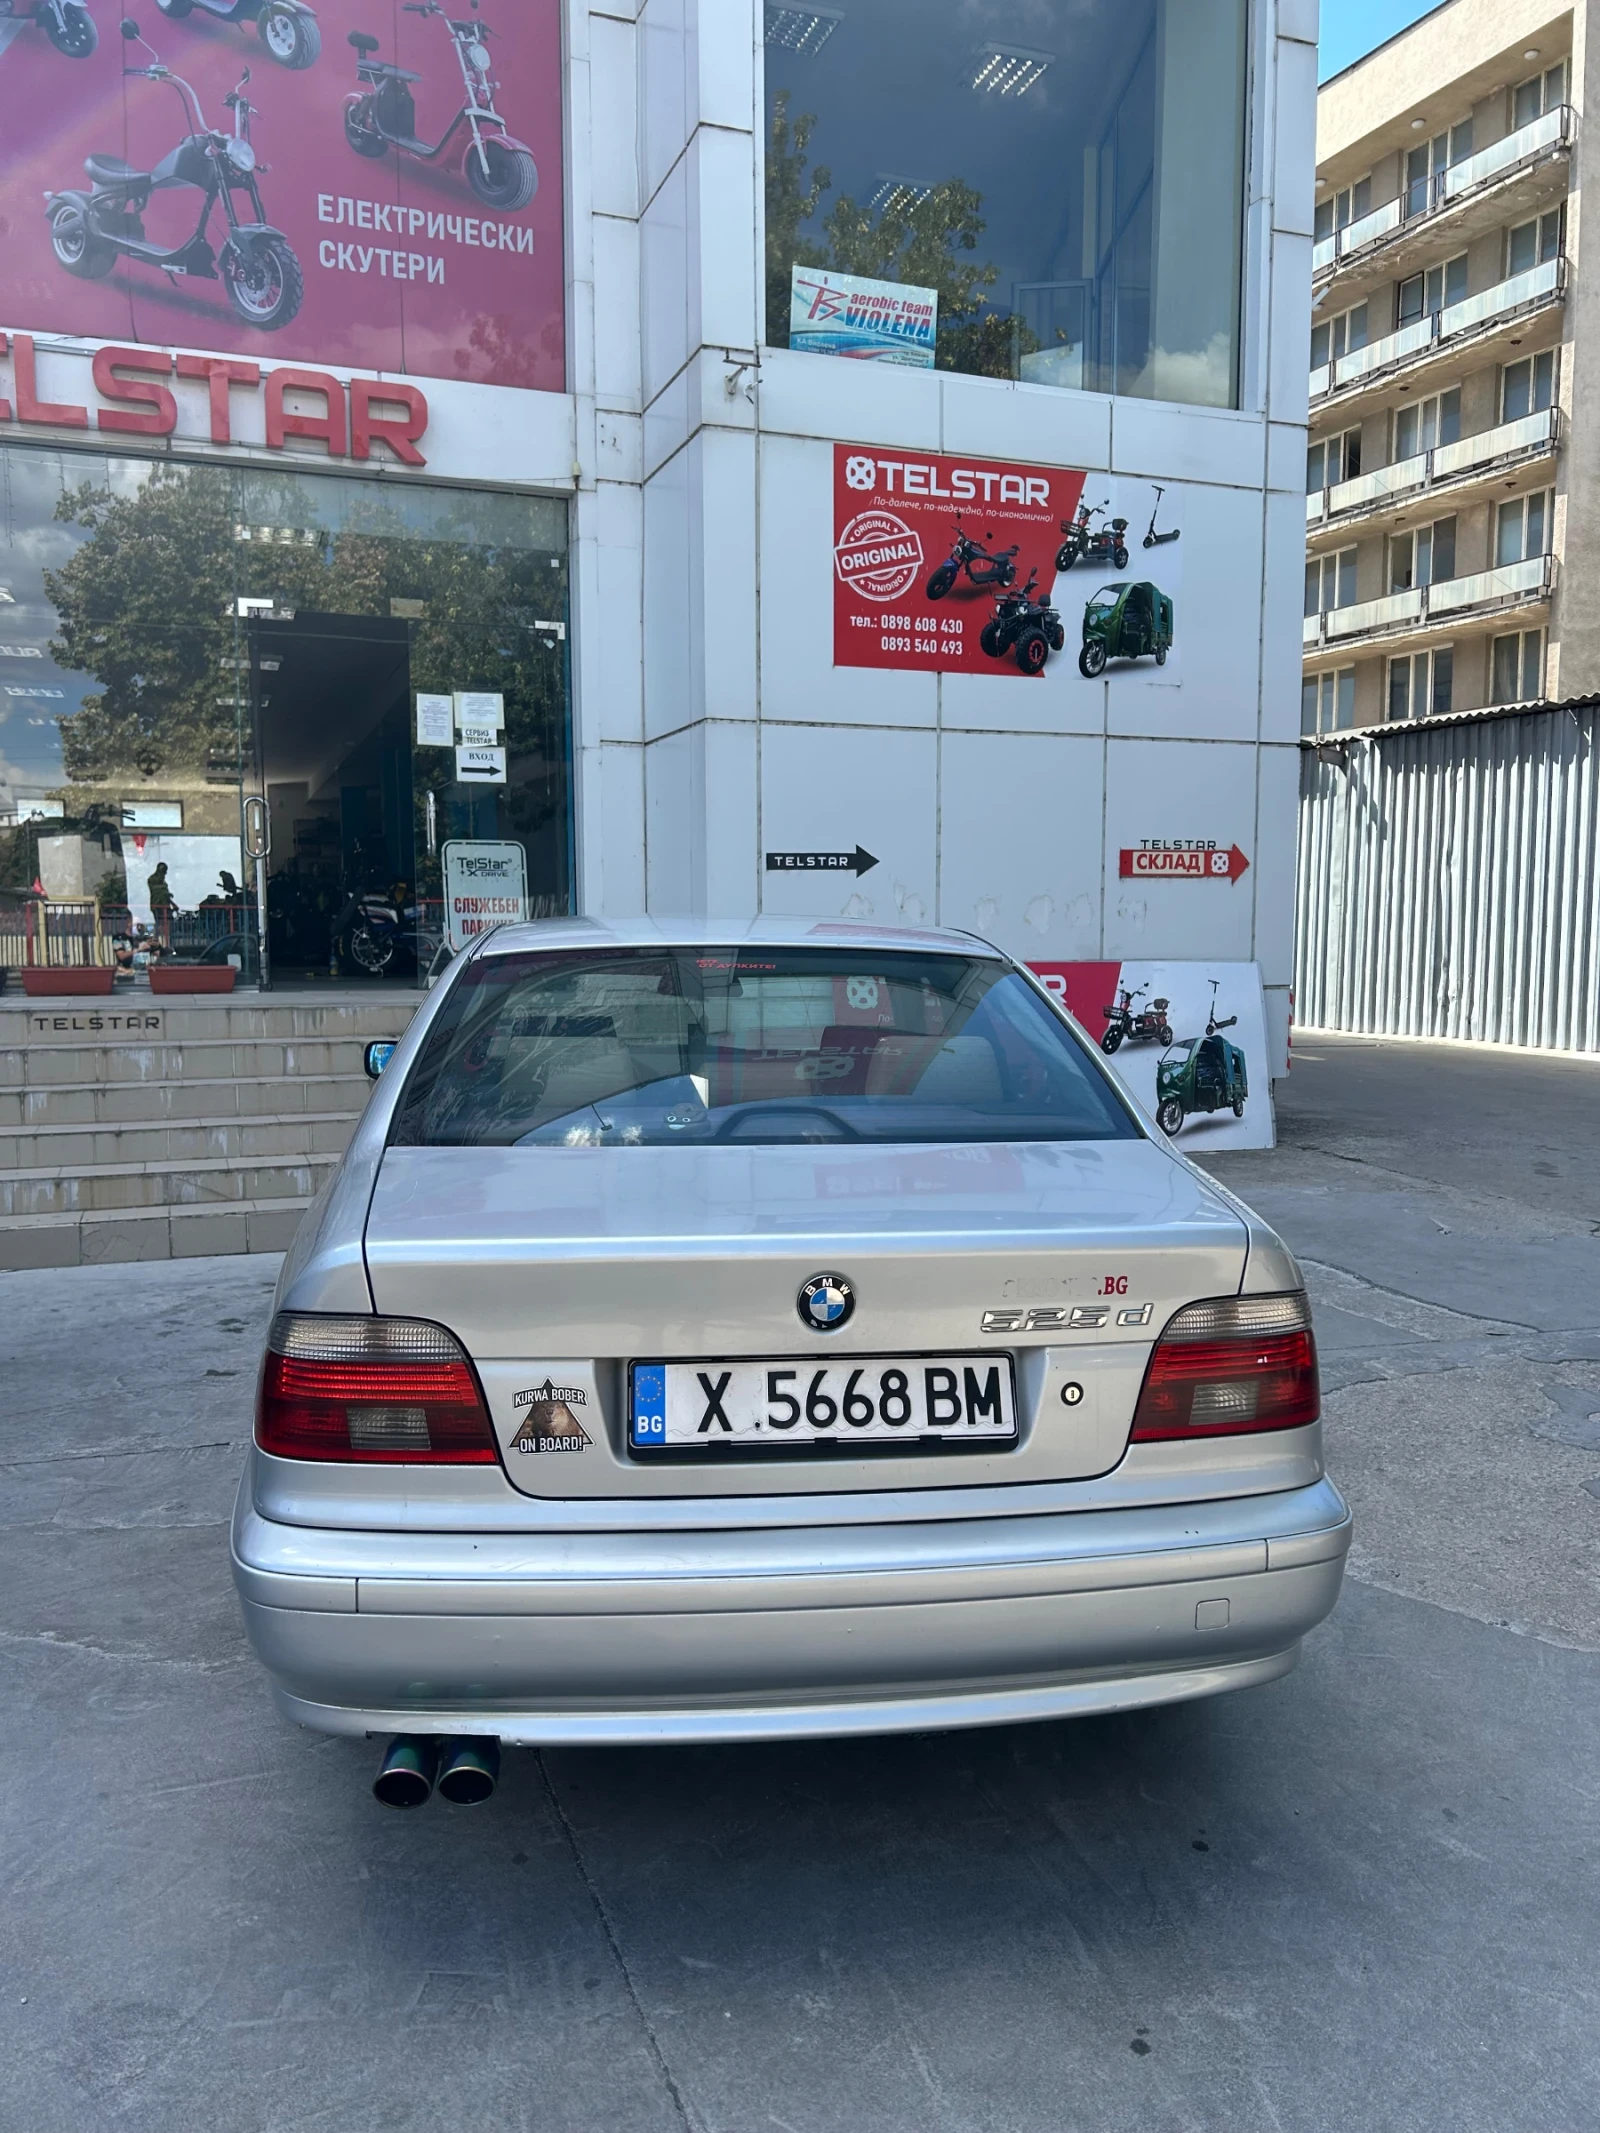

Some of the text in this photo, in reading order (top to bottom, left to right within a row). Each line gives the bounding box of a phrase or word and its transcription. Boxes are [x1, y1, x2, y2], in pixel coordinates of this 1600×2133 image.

[318, 193, 534, 255] ЕЛЕКТРИЧЕСКИ
[319, 240, 445, 285] СКУТЕРИ
[850, 293, 934, 316] aerobic team
[844, 306, 932, 340] VIOLENA
[0, 332, 428, 468] LSTAR
[877, 460, 1050, 508] TELSTAR
[873, 496, 922, 510] По-далече,
[986, 509, 1054, 523] по-икономично!
[854, 520, 891, 537] ORIGINAL
[841, 542, 917, 570] ORIGINAL
[867, 575, 904, 592] ORIGINAL
[850, 614, 963, 634] тел.: 0898 608 430
[881, 636, 963, 655] 0893 540 493
[465, 728, 490, 737] СЕРВИЗ
[466, 737, 493, 745] TELSTAR
[469, 752, 495, 762] ВХОД
[1140, 839, 1217, 851] TELSTAR
[774, 856, 848, 867] TELSTAR
[1136, 853, 1201, 872] СКЛАД
[454, 897, 520, 914] СЛУЖЕБЕН
[34, 1016, 160, 1031] TELSTAR
[804, 1277, 851, 1296] BMW
[515, 1388, 584, 1407] KURWA BOBER
[637, 1366, 1003, 1435] BG X 5668 BM
[520, 1436, 583, 1452] ON BOARD!
